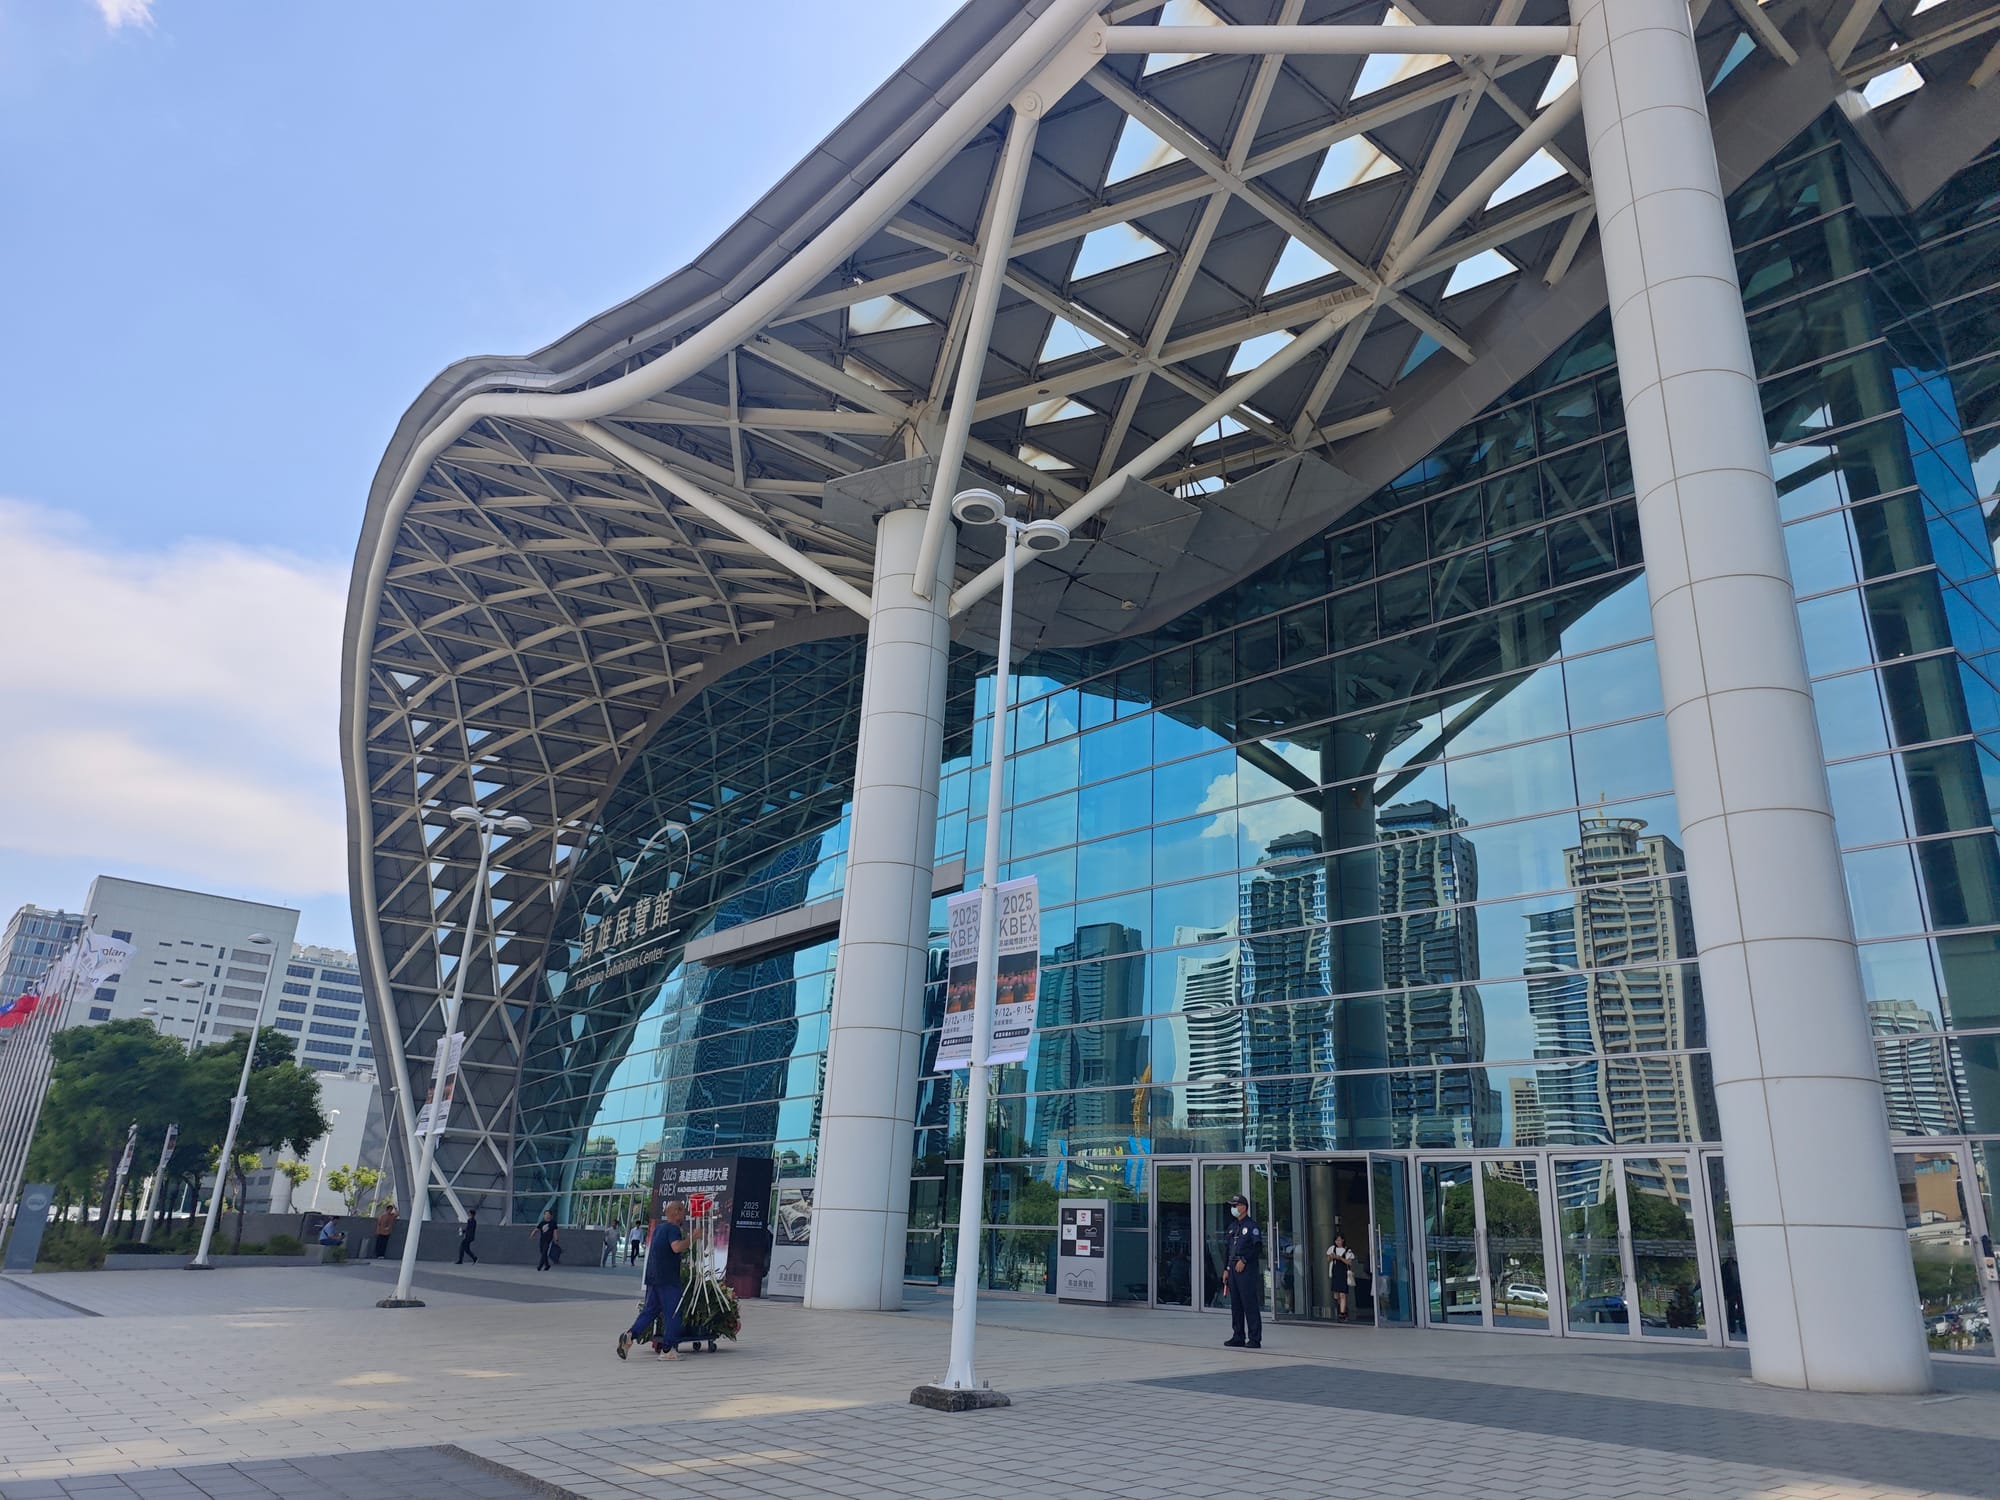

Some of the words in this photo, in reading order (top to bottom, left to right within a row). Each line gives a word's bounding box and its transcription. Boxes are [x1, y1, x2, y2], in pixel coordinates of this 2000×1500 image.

[1003, 892, 1033, 915] 2025
[580, 888, 673, 961] 高雄展覽館
[952, 904, 979, 928] 2025
[999, 912, 1037, 938] KBEX
[950, 925, 980, 950] KBEX
[575, 970, 605, 991] Kaohsiung
[605, 957, 639, 979] Exhibition
[639, 947, 665, 966] Center
[662, 1168, 677, 1181] 2025
[679, 1167, 729, 1183] 高雄國際建材大展
[658, 1183, 677, 1197] KBEX
[740, 1210, 760, 1218] KBEX
[743, 1201, 759, 1210] 2025
